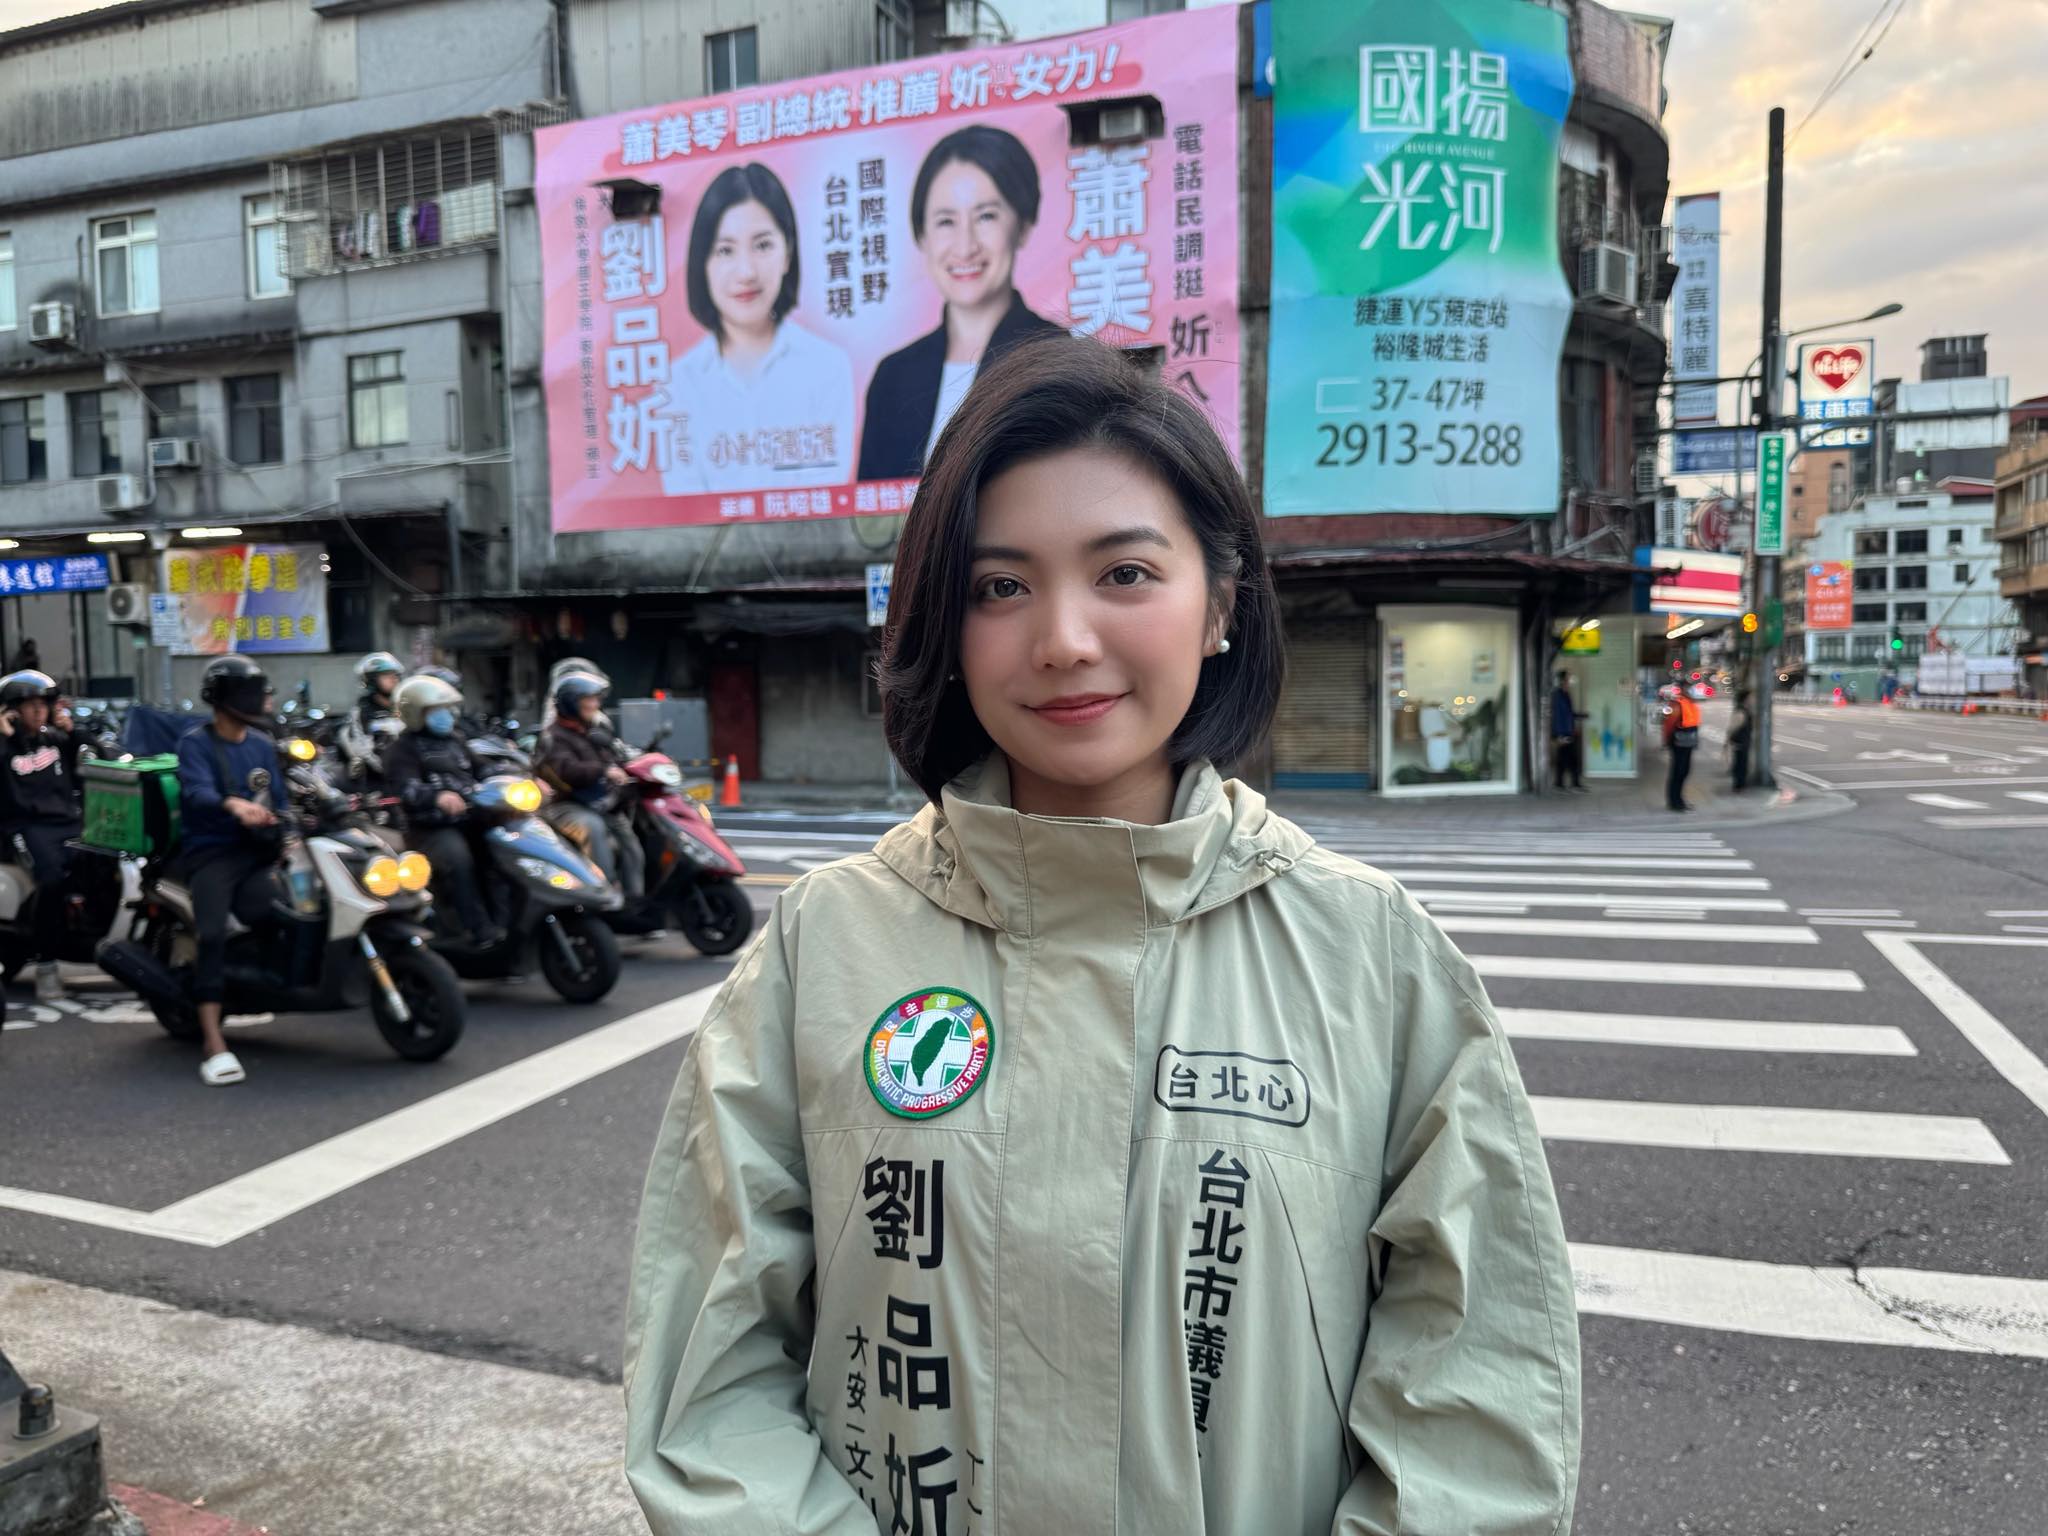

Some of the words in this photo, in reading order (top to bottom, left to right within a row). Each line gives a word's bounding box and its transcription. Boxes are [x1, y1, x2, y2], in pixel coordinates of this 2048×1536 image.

[622, 110, 728, 166] 蕭美琴
[736, 92, 850, 147] 副總統
[859, 71, 940, 125] 推薦
[1359, 44, 1509, 142] 國揚
[825, 176, 855, 319] 台北實現
[859, 158, 889, 304] 國際視野
[1359, 160, 1508, 254] 光河
[601, 213, 674, 475] 劉品妡
[1354, 297, 1509, 328] 捷運Y5預定站
[1372, 333, 1489, 363] 裕隆城生活
[1682, 287, 1710, 373] 喜特麗
[1315, 423, 1522, 467] 2913-5288
[874, 1039, 902, 1101] DEMOCRATIC
[900, 1078, 969, 1109] PROGRESSIVE
[966, 1046, 986, 1081] PARTY
[1168, 1063, 1294, 1112] 台北心
[863, 1156, 958, 1536] 劉品妡
[1183, 1148, 1251, 1458] 台北市議員
